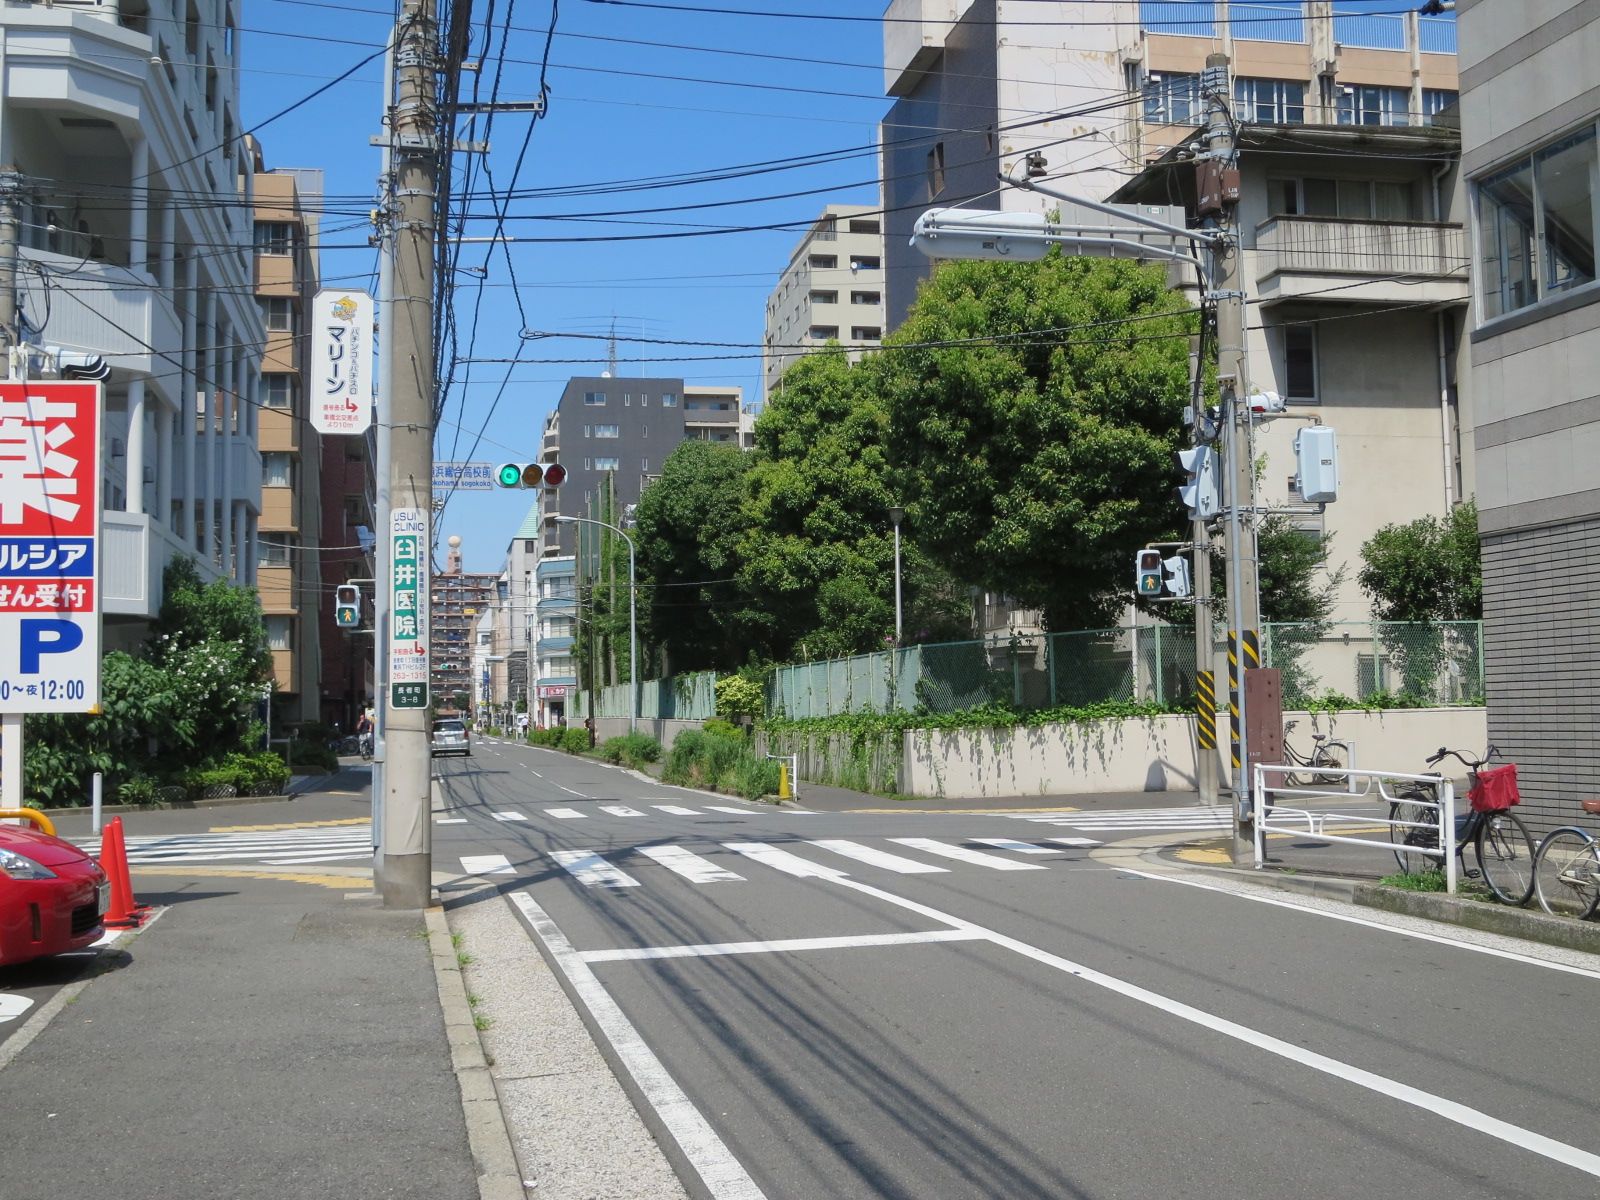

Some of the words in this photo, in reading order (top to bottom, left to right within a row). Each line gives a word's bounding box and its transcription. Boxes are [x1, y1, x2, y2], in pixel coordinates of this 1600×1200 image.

[327, 325, 346, 394] マリーン
[394, 512, 417, 521] USUI
[394, 522, 425, 532] CLINIC
[395, 538, 416, 636] 臼井医院
[20, 619, 84, 674] P
[398, 686, 421, 694] 長者町
